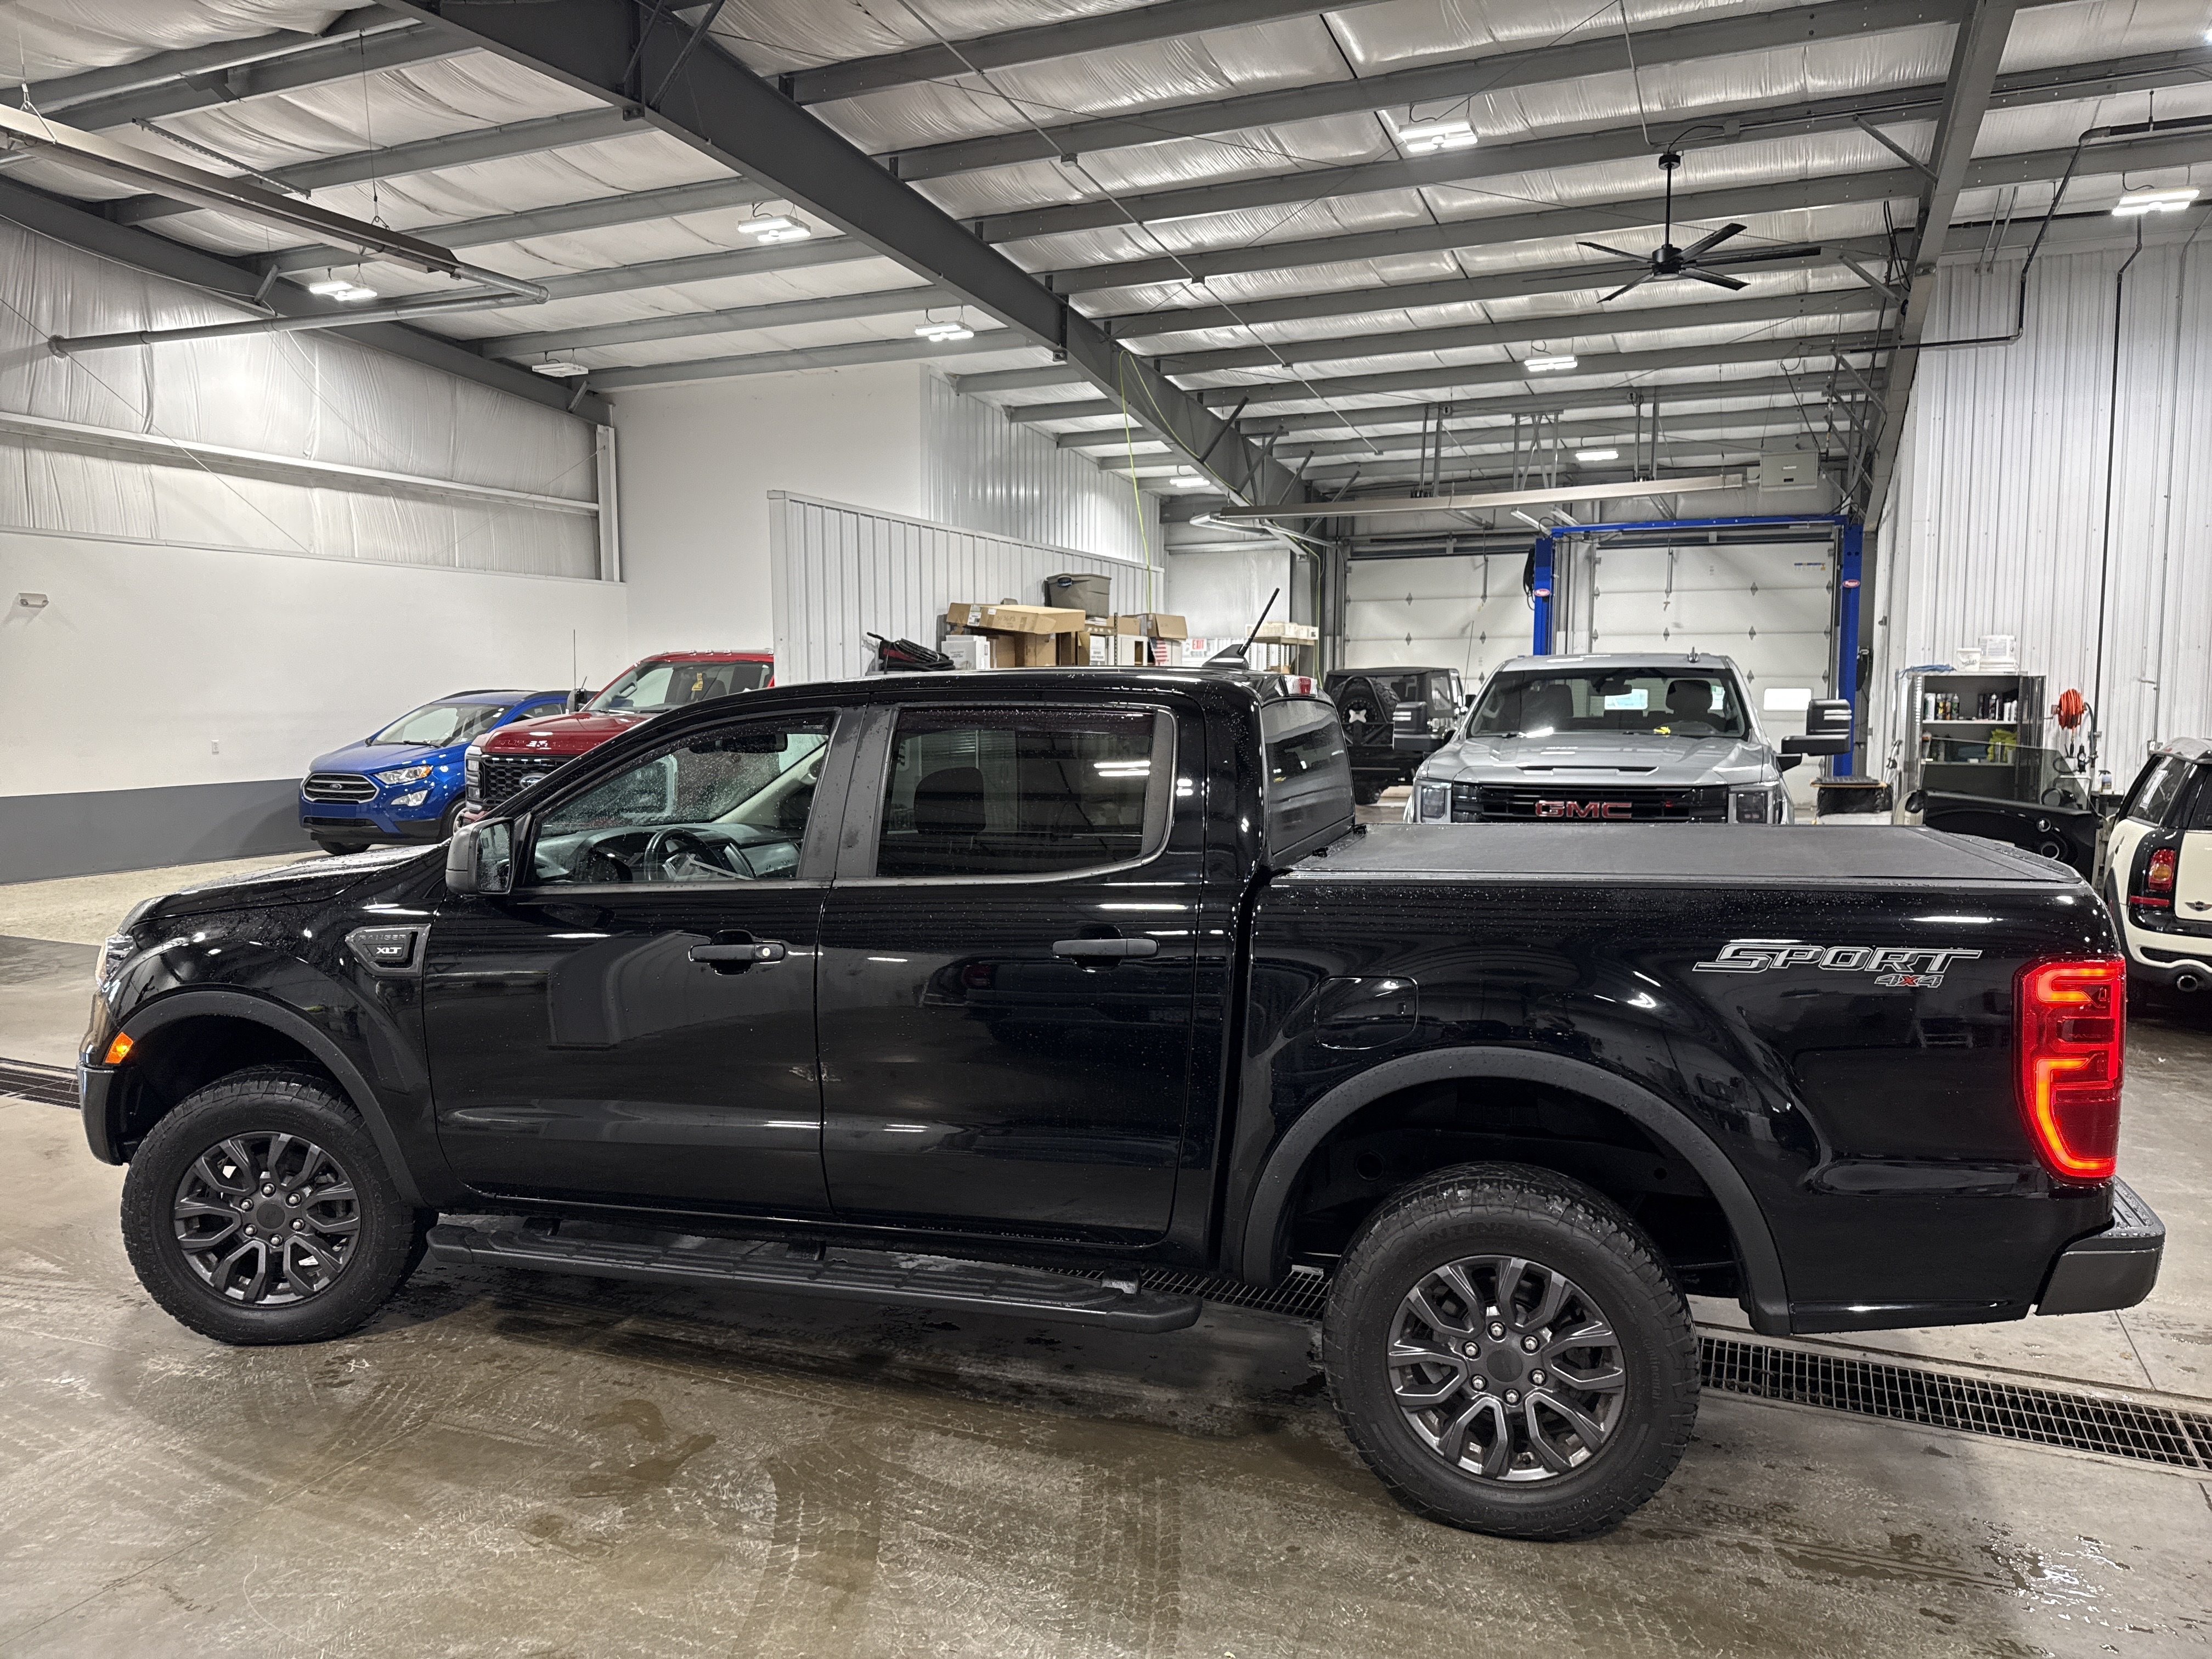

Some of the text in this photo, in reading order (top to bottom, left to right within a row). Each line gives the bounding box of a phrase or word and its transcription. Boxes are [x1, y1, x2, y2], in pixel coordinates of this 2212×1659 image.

[1192, 639, 1204, 650] EXIT
[1535, 800, 1632, 819] GMC
[1692, 943, 1983, 973] SPORT
